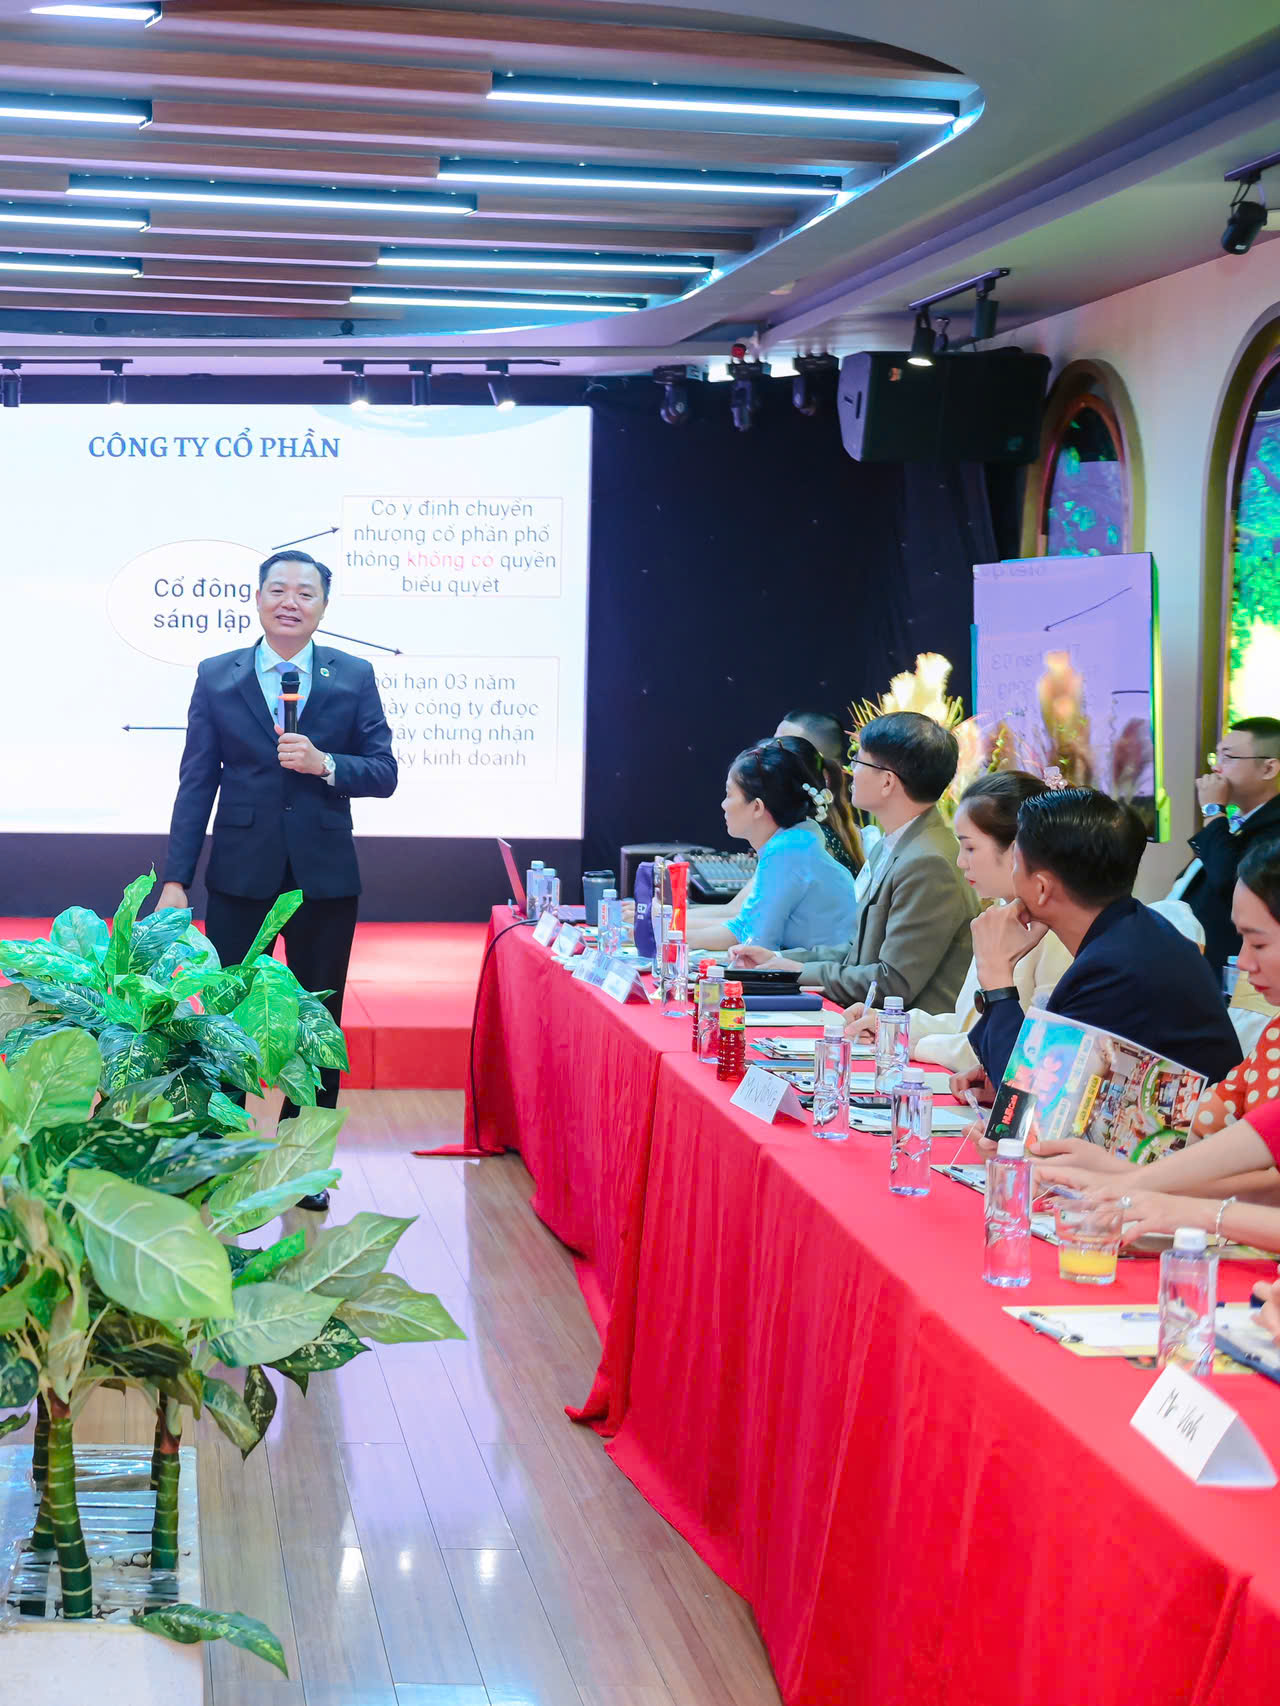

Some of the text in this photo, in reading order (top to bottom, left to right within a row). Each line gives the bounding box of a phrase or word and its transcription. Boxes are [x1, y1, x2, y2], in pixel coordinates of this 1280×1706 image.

[88, 427, 341, 458] CÔNG TY CỔ PHẦN
[154, 575, 251, 603] Cổ đông
[154, 608, 251, 633] sáng lập
[444, 673, 468, 690] 03
[469, 700, 484, 719] ty
[423, 748, 461, 766] kinh
[468, 749, 526, 766] doanh
